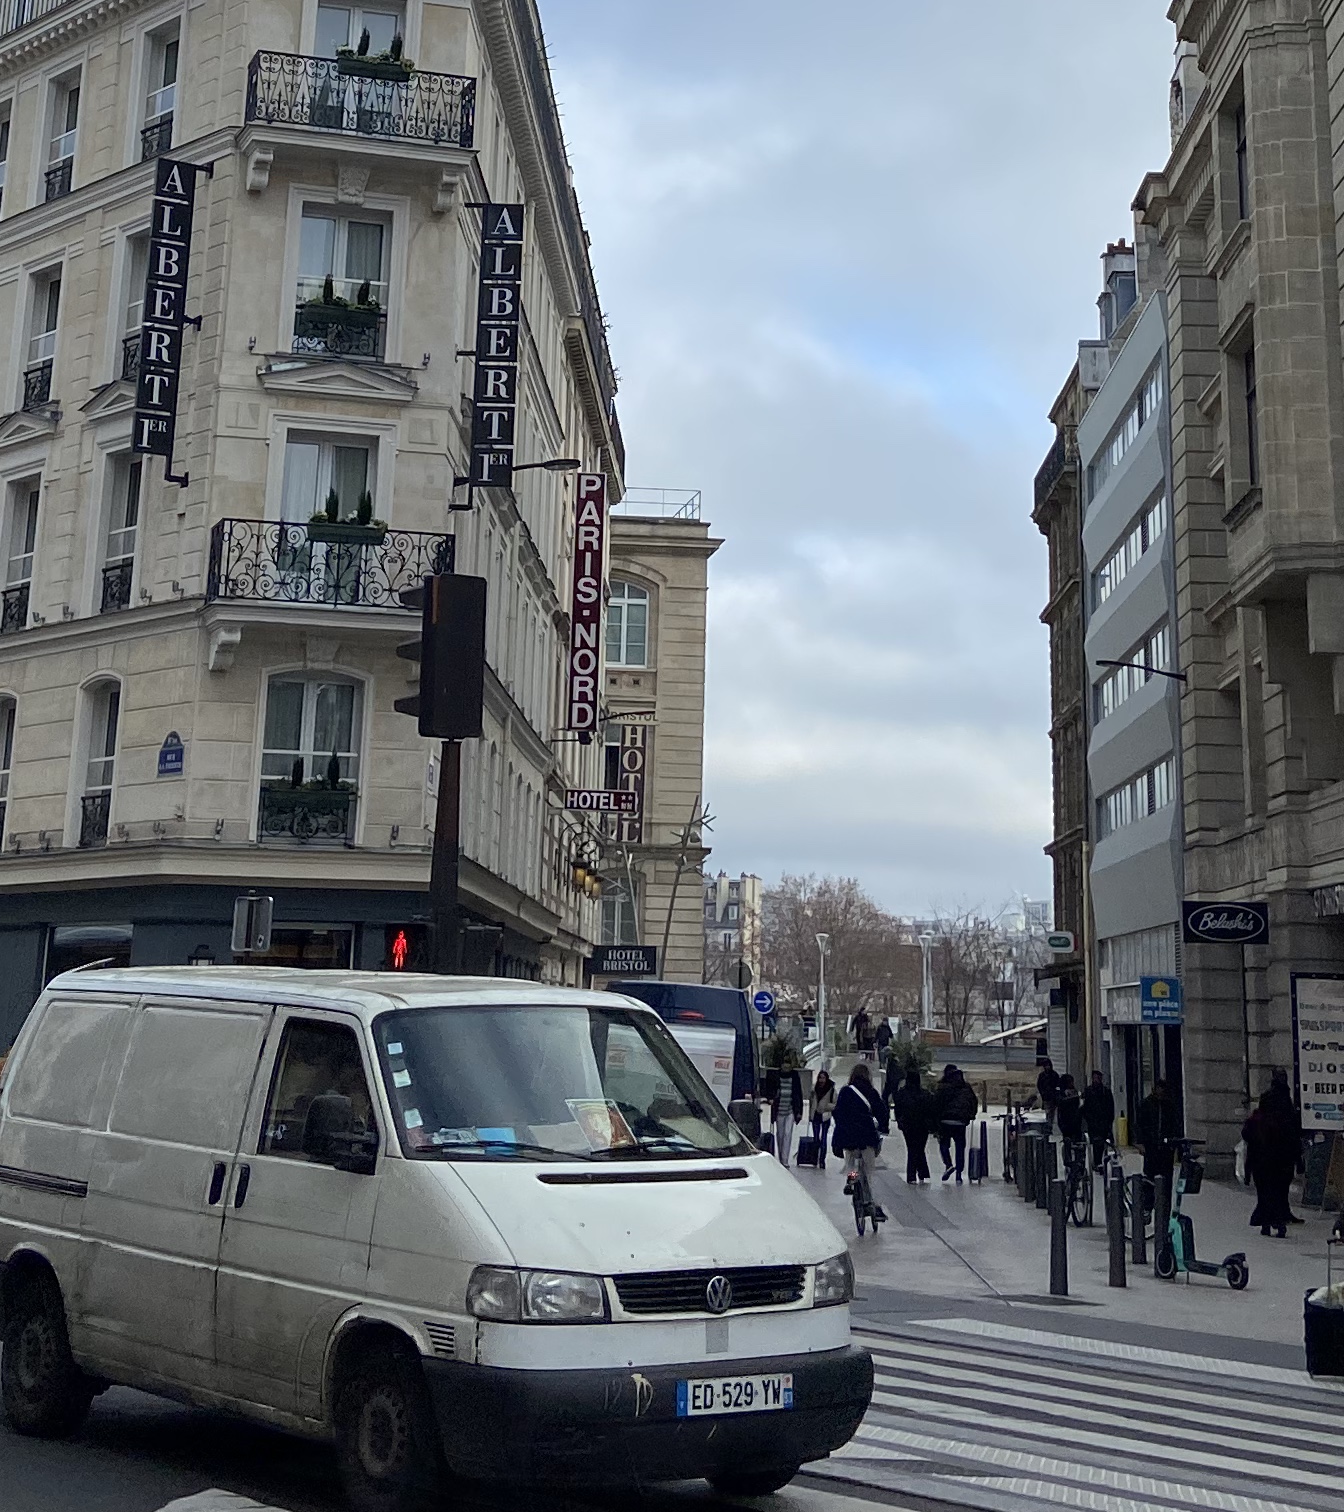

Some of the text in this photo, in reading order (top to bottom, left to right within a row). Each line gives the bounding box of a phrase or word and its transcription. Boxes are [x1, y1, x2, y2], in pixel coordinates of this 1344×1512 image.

[144, 164, 186, 406] ALBERT
[483, 207, 517, 440] ALBERT
[566, 791, 619, 810] HOTEL
[1198, 911, 1255, 931] Belushi's
[608, 949, 646, 960] HOTEL
[602, 960, 652, 971] BRISTOL
[1314, 1082, 1337, 1094] BEER
